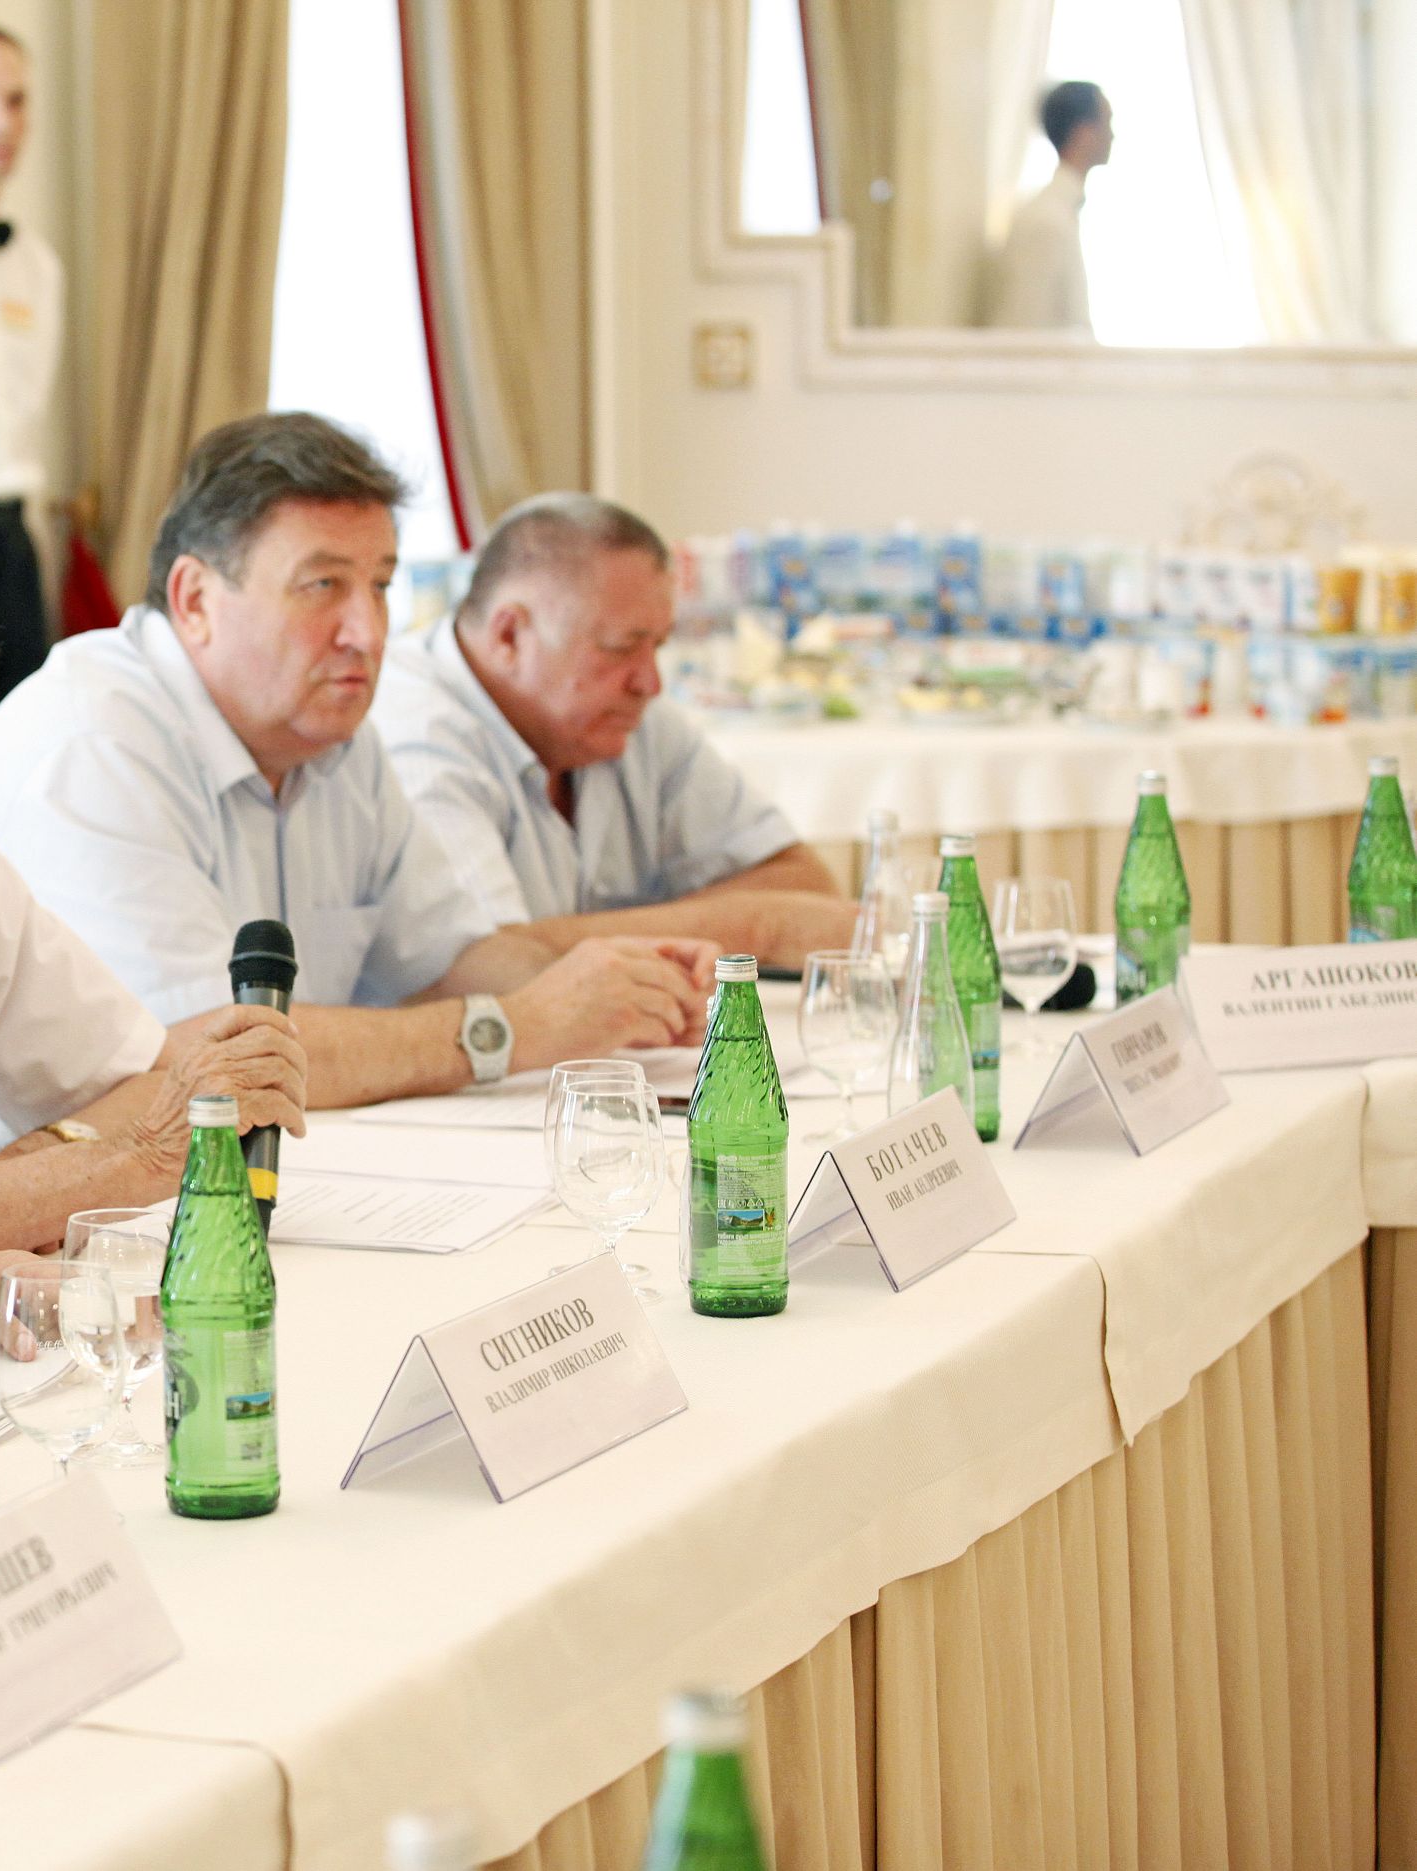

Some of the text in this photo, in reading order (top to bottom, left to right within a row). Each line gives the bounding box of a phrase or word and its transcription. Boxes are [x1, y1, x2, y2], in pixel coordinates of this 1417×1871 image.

[865, 1121, 948, 1183] БОГАЧЕВ
[885, 1158, 963, 1211] ИВАН АНДРЕЕВИЧ
[479, 1297, 595, 1372] СИТНИКОВ
[484, 1331, 629, 1414] ВЛАДИМИР НИКОЛАЕВИЧ
